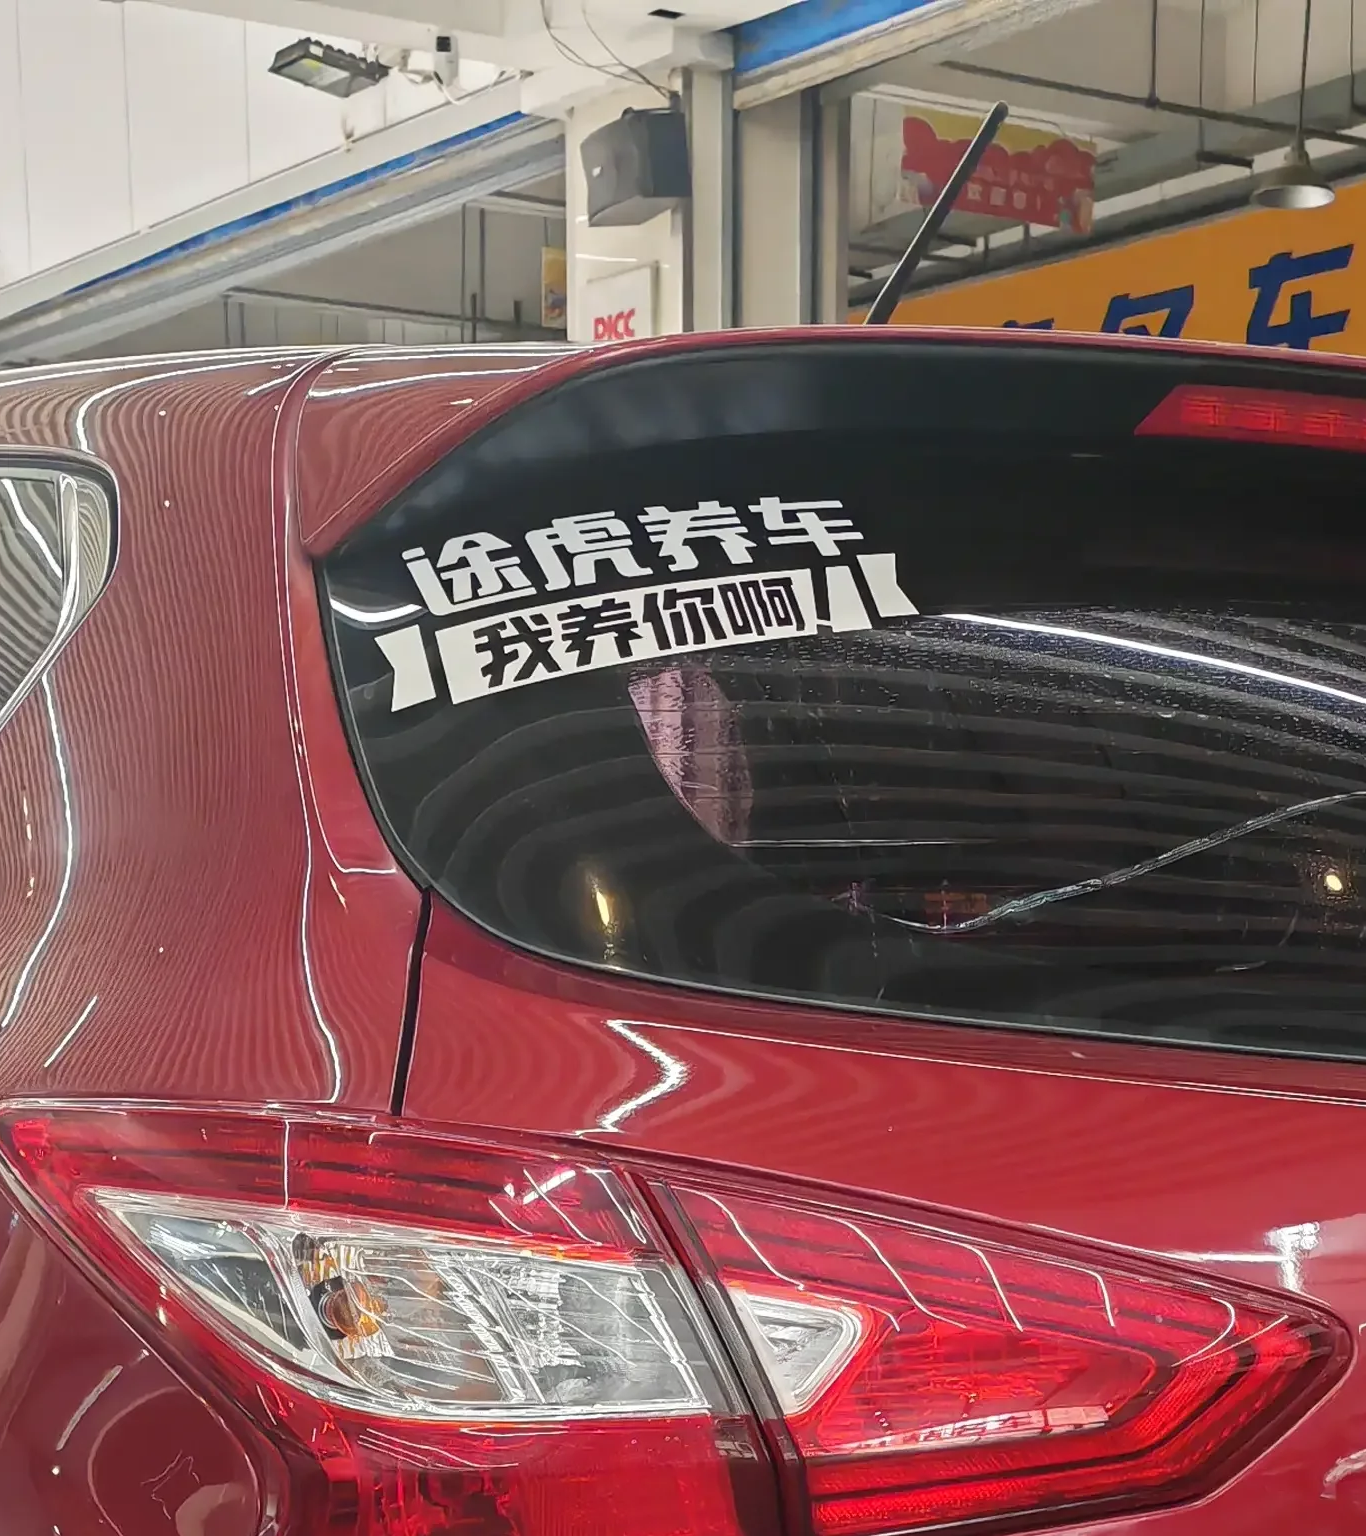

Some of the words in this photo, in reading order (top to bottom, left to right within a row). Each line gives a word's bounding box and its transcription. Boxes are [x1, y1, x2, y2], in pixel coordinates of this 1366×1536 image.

[401, 496, 864, 617] 途虎养车
[473, 576, 804, 688] 我养你啊
